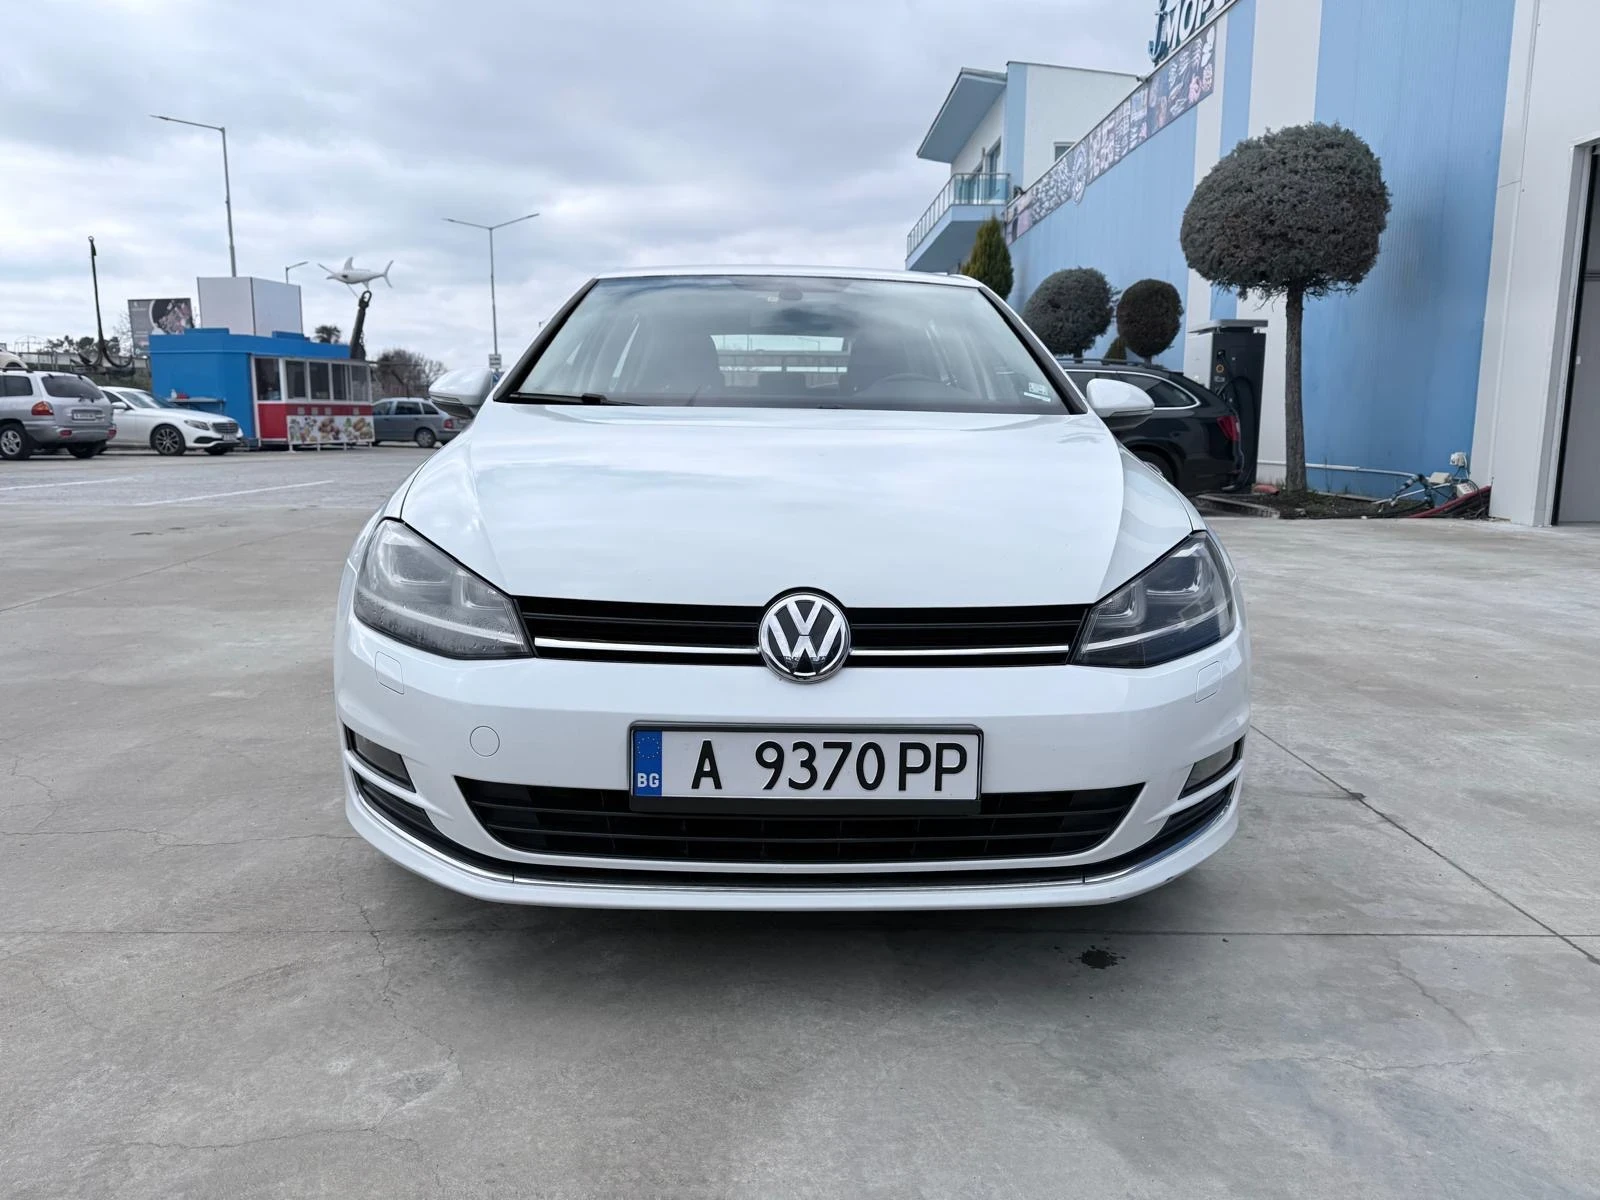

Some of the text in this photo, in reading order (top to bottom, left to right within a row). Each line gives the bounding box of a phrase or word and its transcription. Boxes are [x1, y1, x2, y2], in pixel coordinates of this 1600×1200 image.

[768, 600, 844, 674] VW
[637, 773, 660, 788] BG
[691, 740, 967, 792] A 9370 PP
